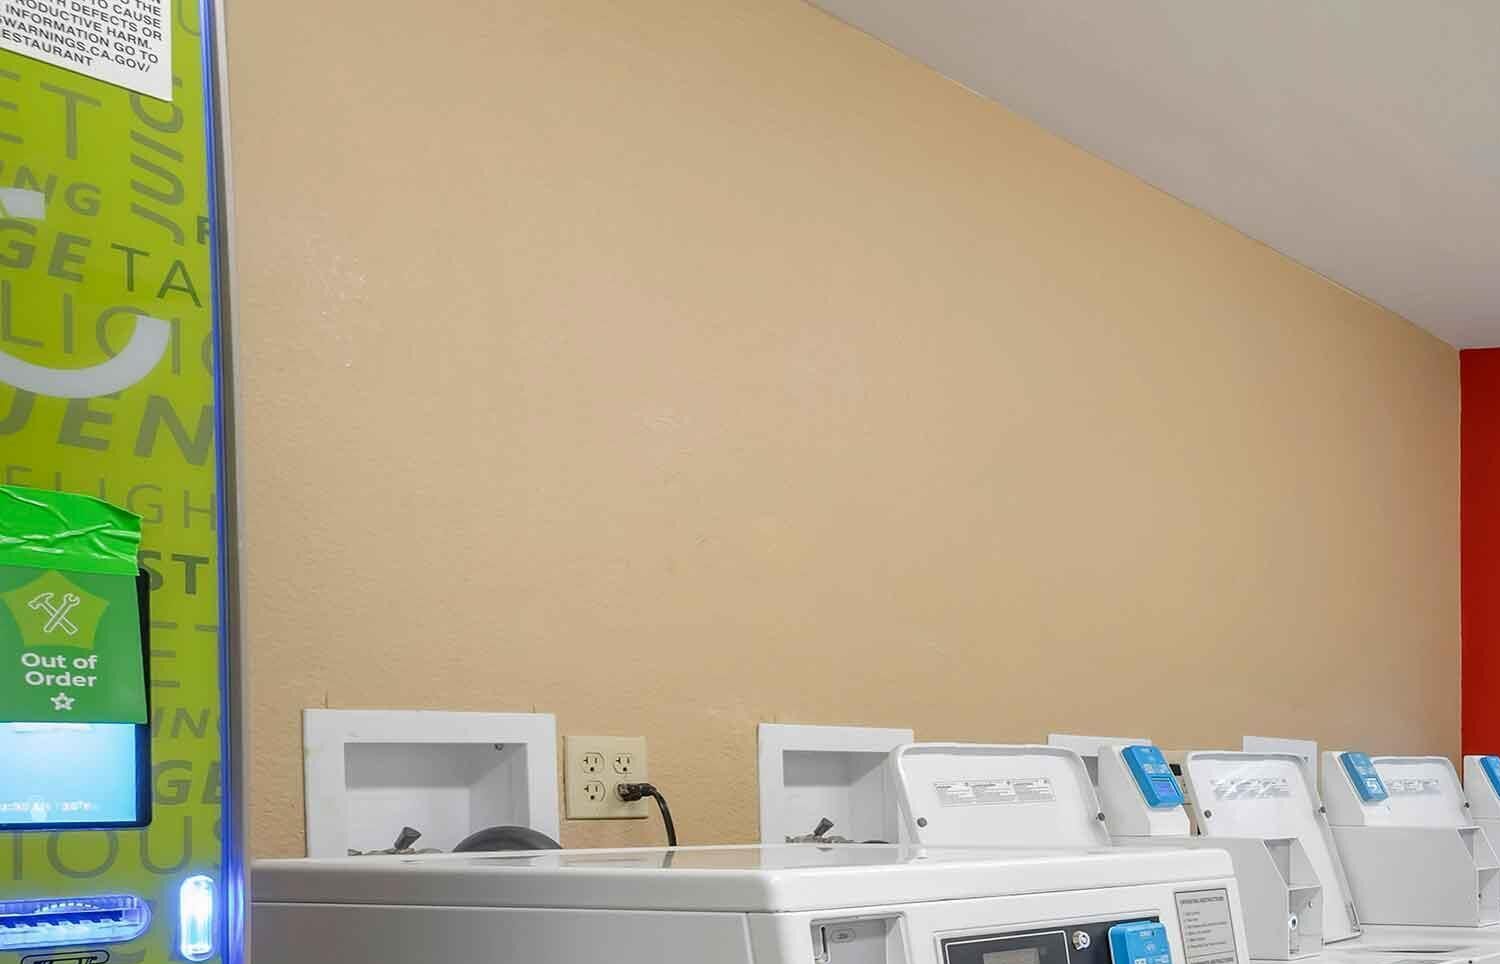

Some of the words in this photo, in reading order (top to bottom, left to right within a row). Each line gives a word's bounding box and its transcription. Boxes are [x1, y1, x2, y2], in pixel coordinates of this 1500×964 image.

[72, 2, 137, 32] DEFECTS
[142, 27, 162, 40] OR
[113, 5, 160, 29] CAUSE
[6, 4, 109, 47] INFORMATION
[114, 42, 135, 55] GO
[139, 50, 158, 63] TO
[107, 26, 152, 49] HARM.
[21, 652, 68, 669] Out
[72, 653, 98, 670] of
[25, 670, 97, 688] Order
